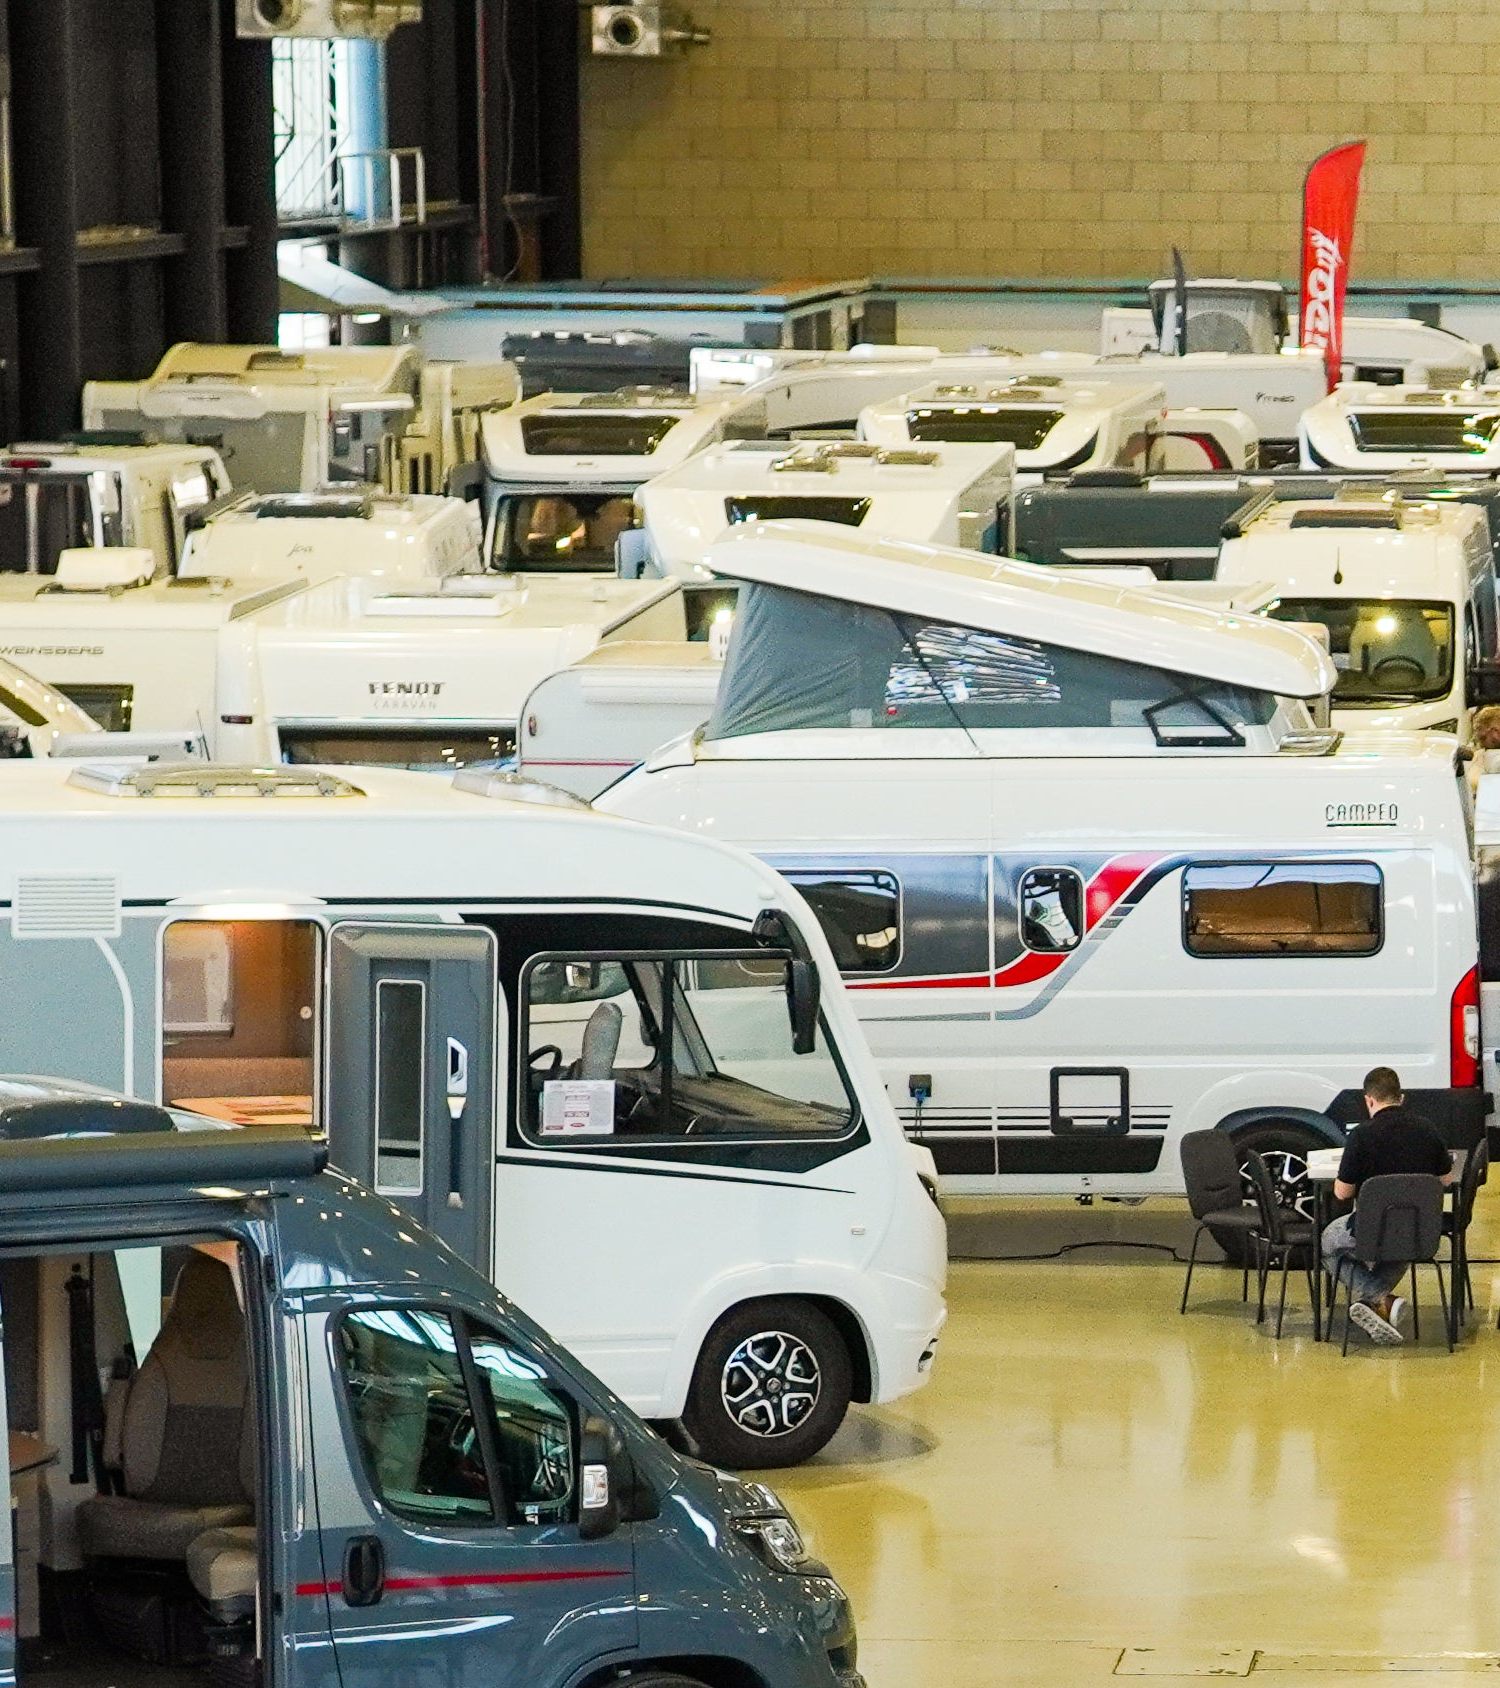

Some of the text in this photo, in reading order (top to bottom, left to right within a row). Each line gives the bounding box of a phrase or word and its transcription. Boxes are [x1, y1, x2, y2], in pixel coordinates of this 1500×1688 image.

[367, 681, 447, 696] FENDT
[372, 698, 438, 711] CARAVAN
[1325, 803, 1399, 823] CAMPEO
